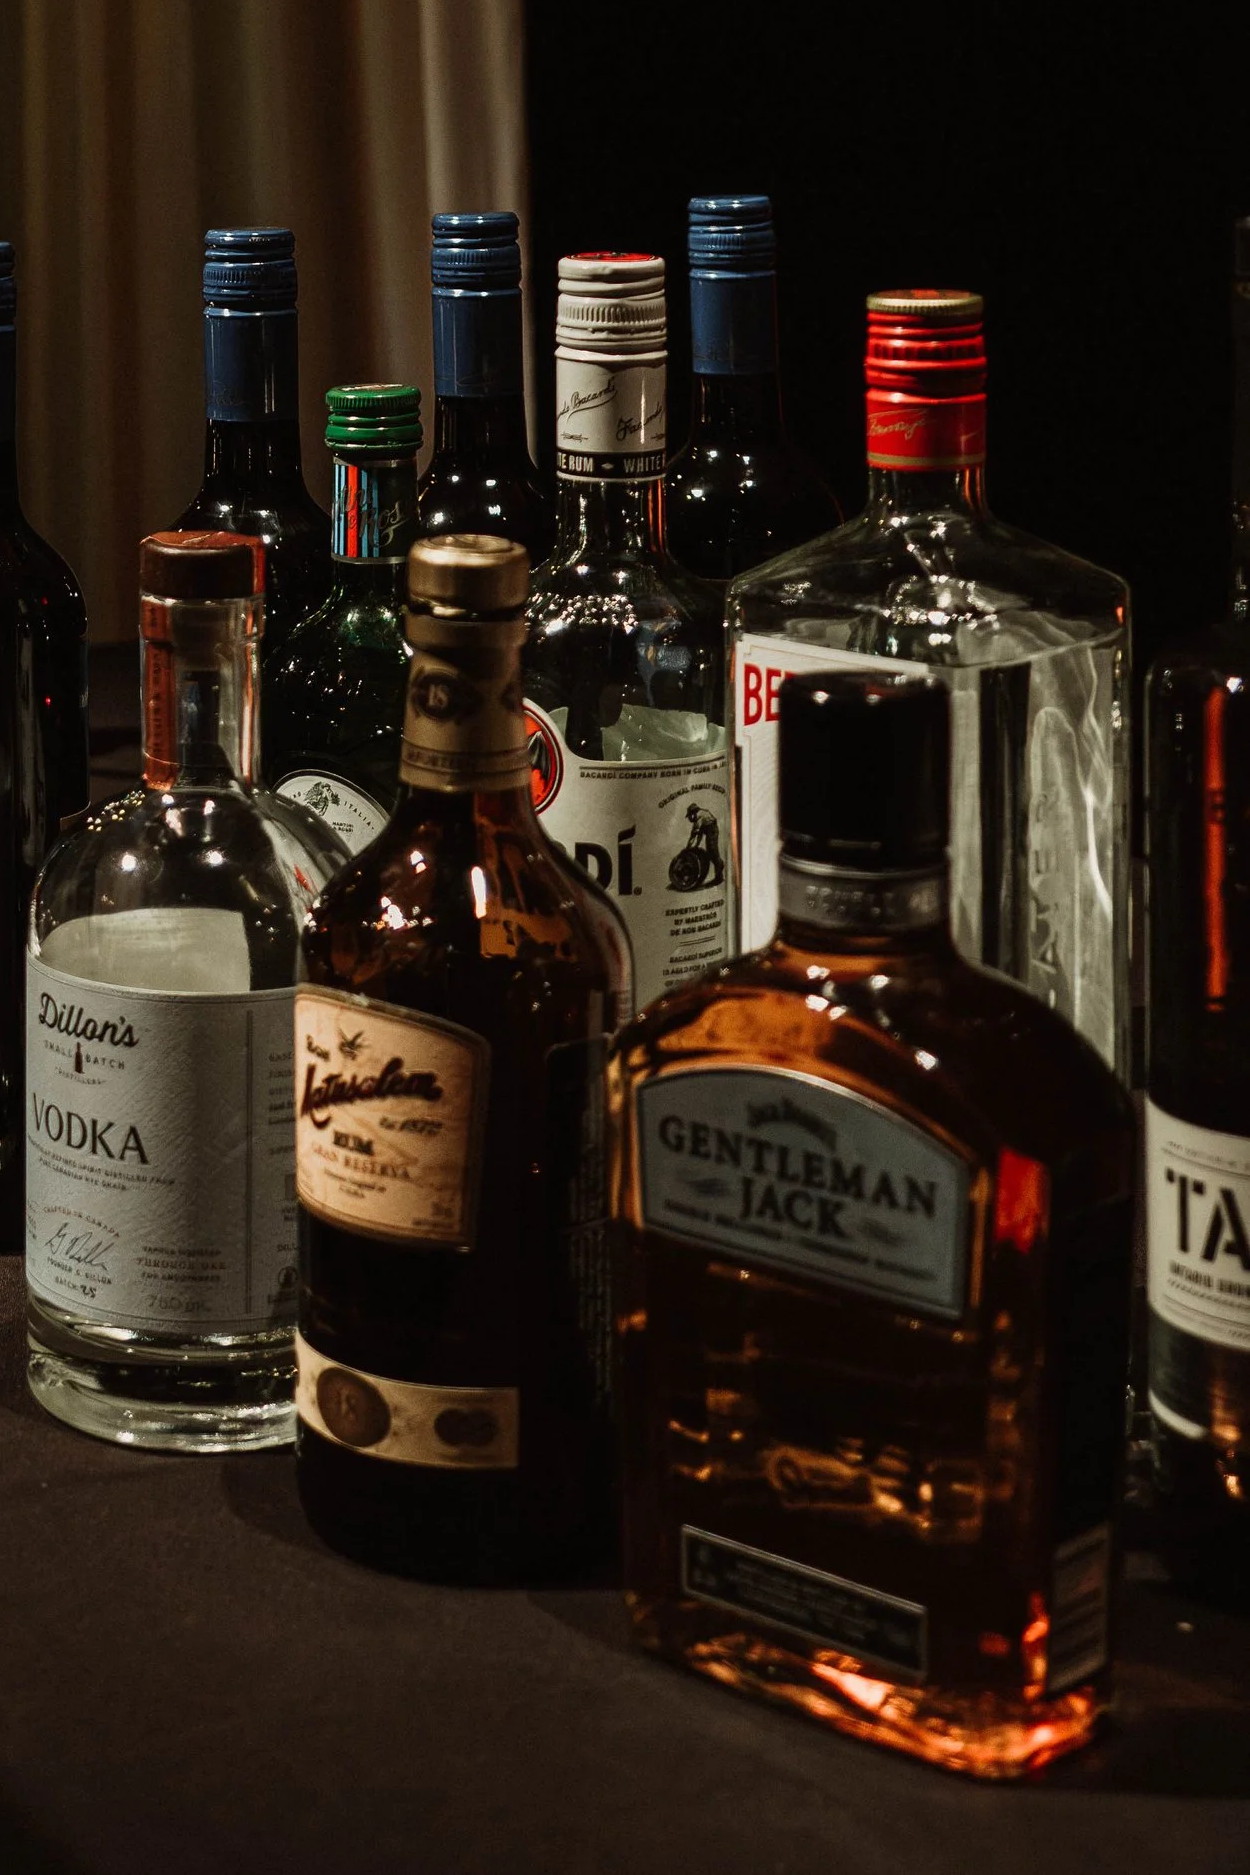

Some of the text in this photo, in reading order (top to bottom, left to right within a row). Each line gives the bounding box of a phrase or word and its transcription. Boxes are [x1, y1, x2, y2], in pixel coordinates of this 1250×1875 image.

[569, 454, 594, 472] RUM
[623, 455, 661, 473] WHITE
[660, 770, 681, 778] BORN
[693, 766, 710, 774] CUBA
[659, 786, 689, 808] ORIGINAL
[691, 782, 712, 792] FAMILY
[344, 801, 371, 826] ITALIA
[666, 899, 724, 916] EXPERTLY CRAFTED
[674, 918, 683, 926] BY
[682, 926, 696, 935] RON
[38, 993, 139, 1047] Dillon's
[85, 1054, 125, 1070] BATCH
[32, 1092, 149, 1164] VODKA
[343, 1155, 411, 1180] RESERVA
[658, 1114, 937, 1220] GENTLEMAN
[740, 1176, 853, 1240] JACK
[85, 1215, 120, 1237] CANADA
